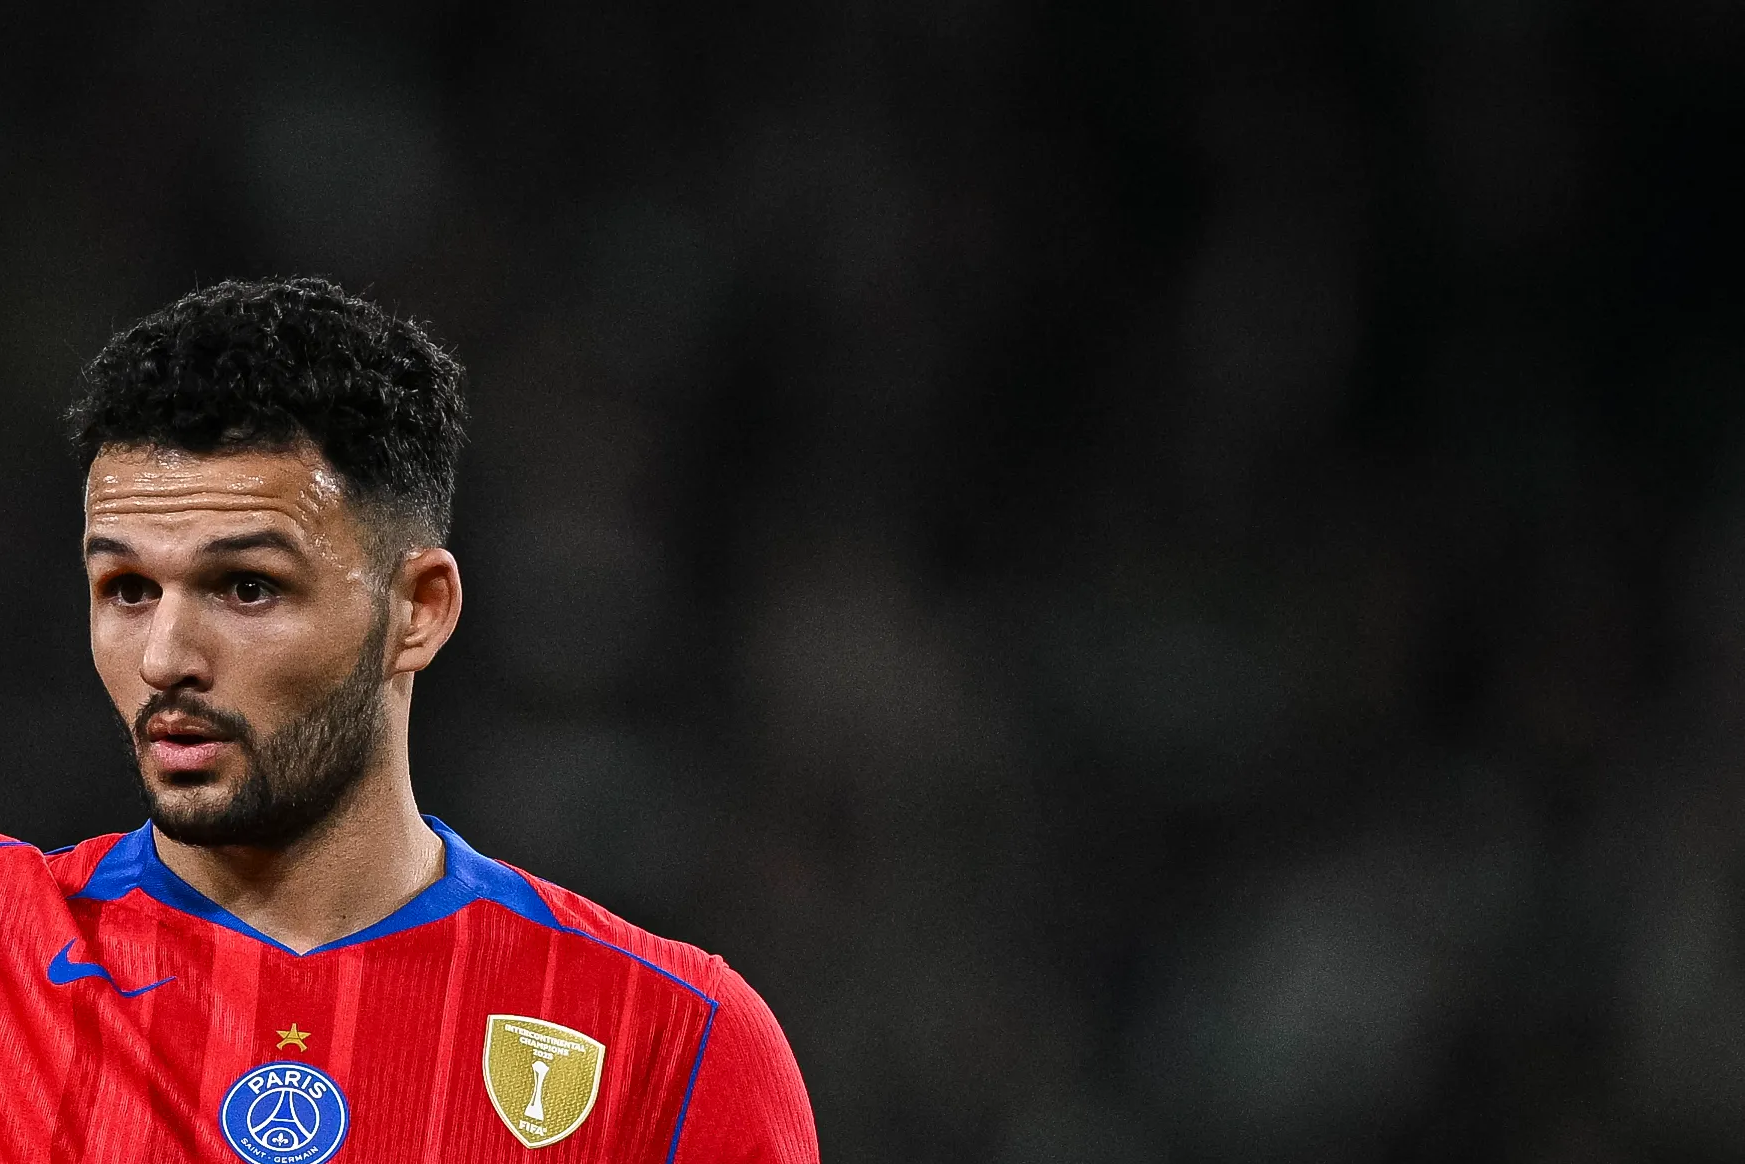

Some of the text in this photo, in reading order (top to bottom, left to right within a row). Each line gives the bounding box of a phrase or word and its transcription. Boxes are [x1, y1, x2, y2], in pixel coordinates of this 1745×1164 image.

[519, 1036, 570, 1057] CHAMPIONS
[247, 1070, 327, 1099] PARIS
[518, 1119, 545, 1137] FIFA
[240, 1137, 320, 1164] SAINT GERMAIN
